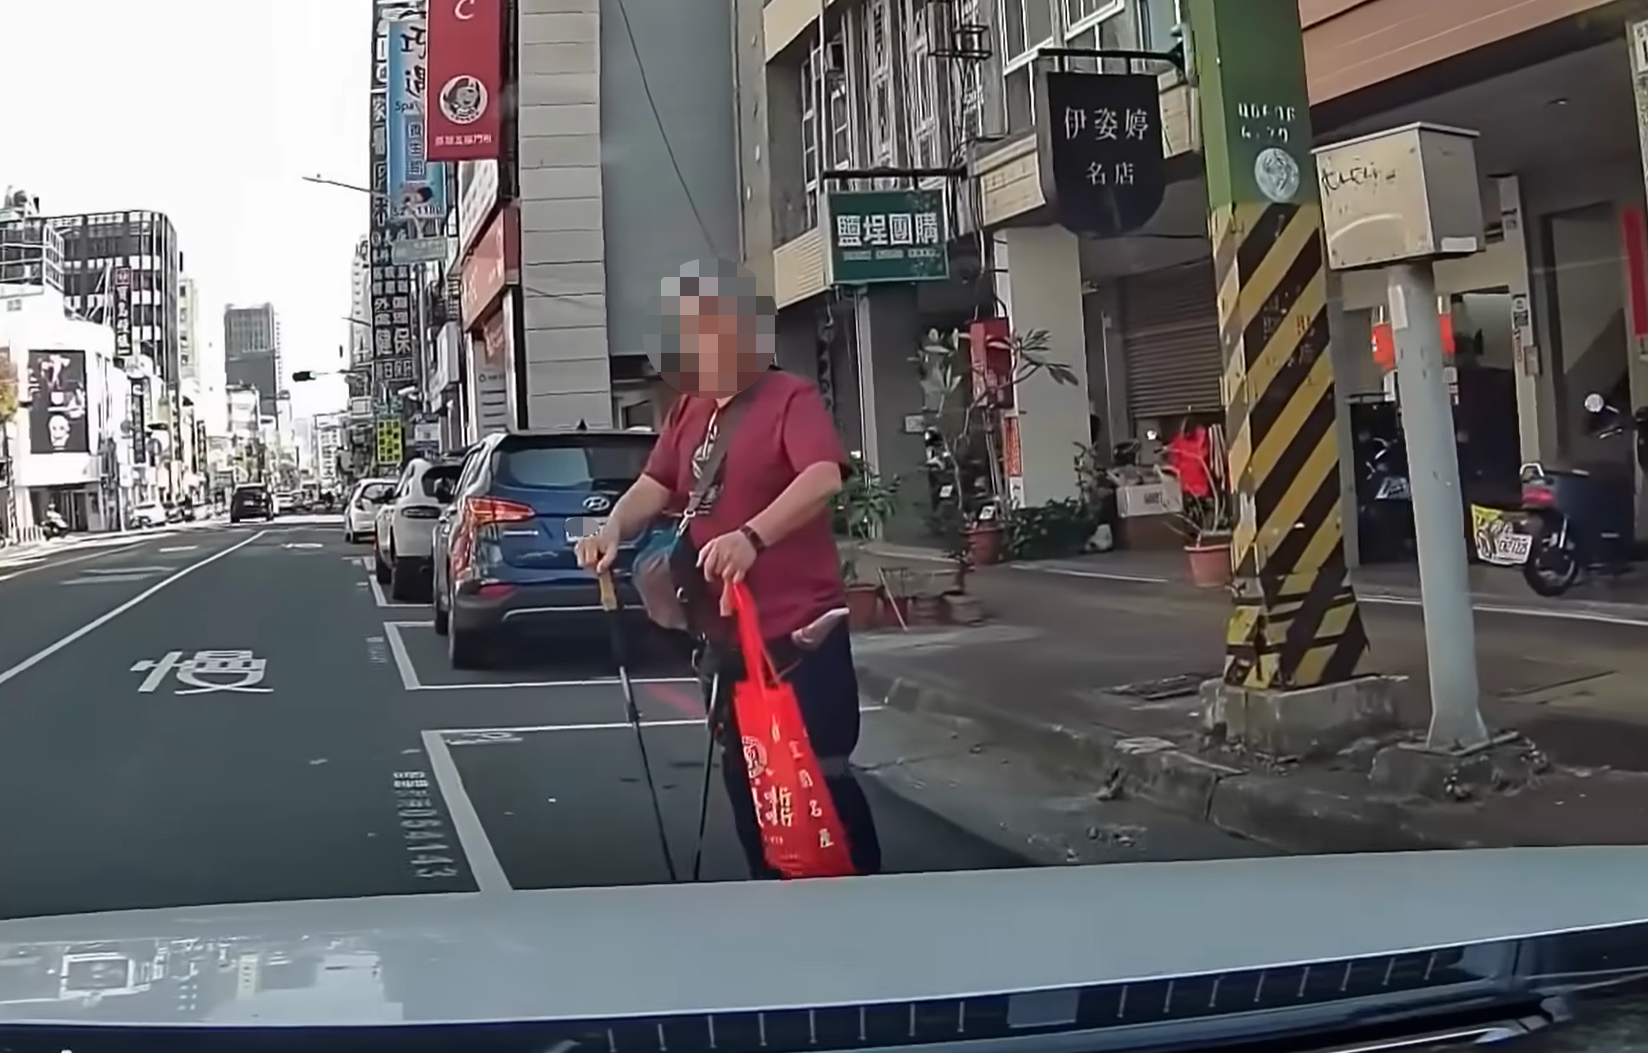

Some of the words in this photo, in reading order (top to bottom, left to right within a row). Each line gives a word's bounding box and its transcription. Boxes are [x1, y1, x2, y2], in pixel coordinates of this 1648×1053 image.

[1064, 106, 1149, 140] 伊姿婷
[1086, 161, 1134, 185] 名店
[837, 212, 938, 246] 鹽埕團購
[130, 650, 274, 695] 慢
